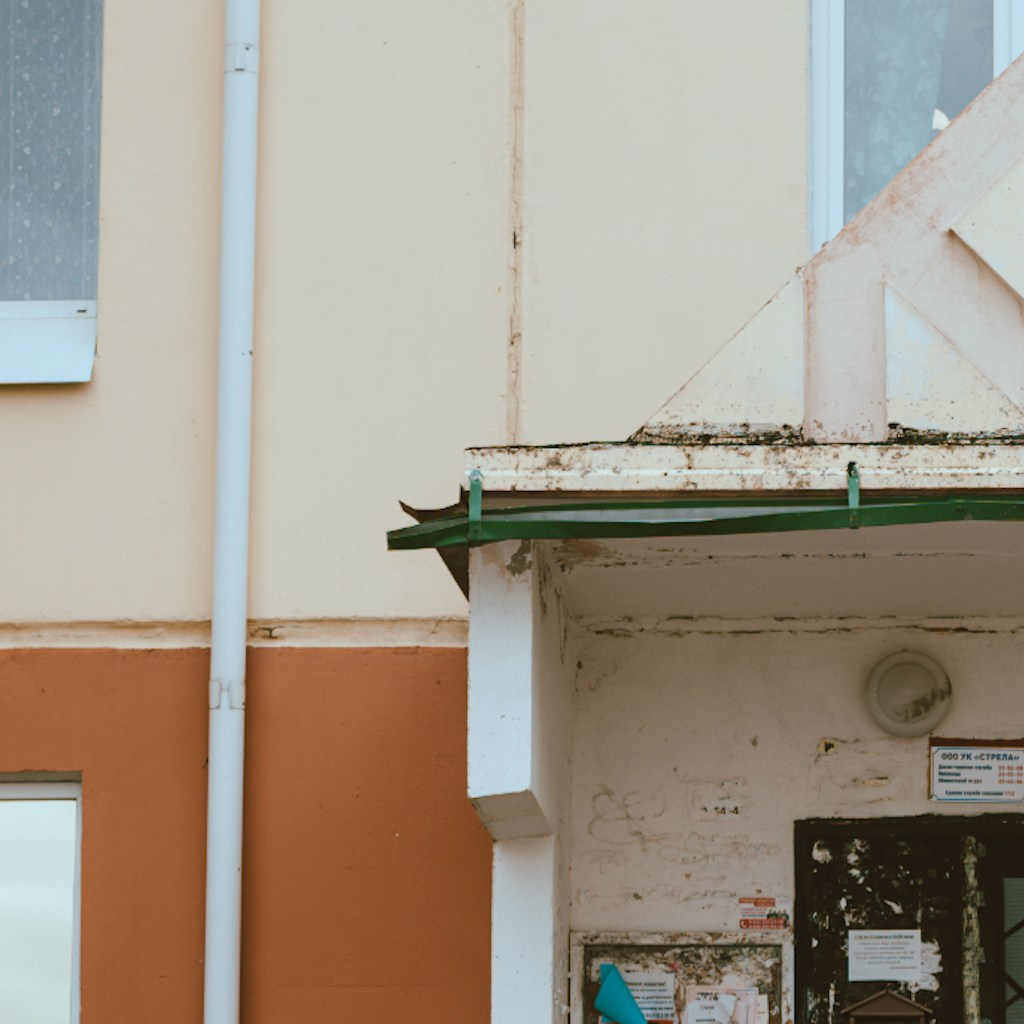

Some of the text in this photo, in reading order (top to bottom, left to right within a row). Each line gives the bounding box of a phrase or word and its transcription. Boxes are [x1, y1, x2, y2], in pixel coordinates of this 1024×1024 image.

[941, 753, 1020, 761] ООО УК «СТРЕЛА»
